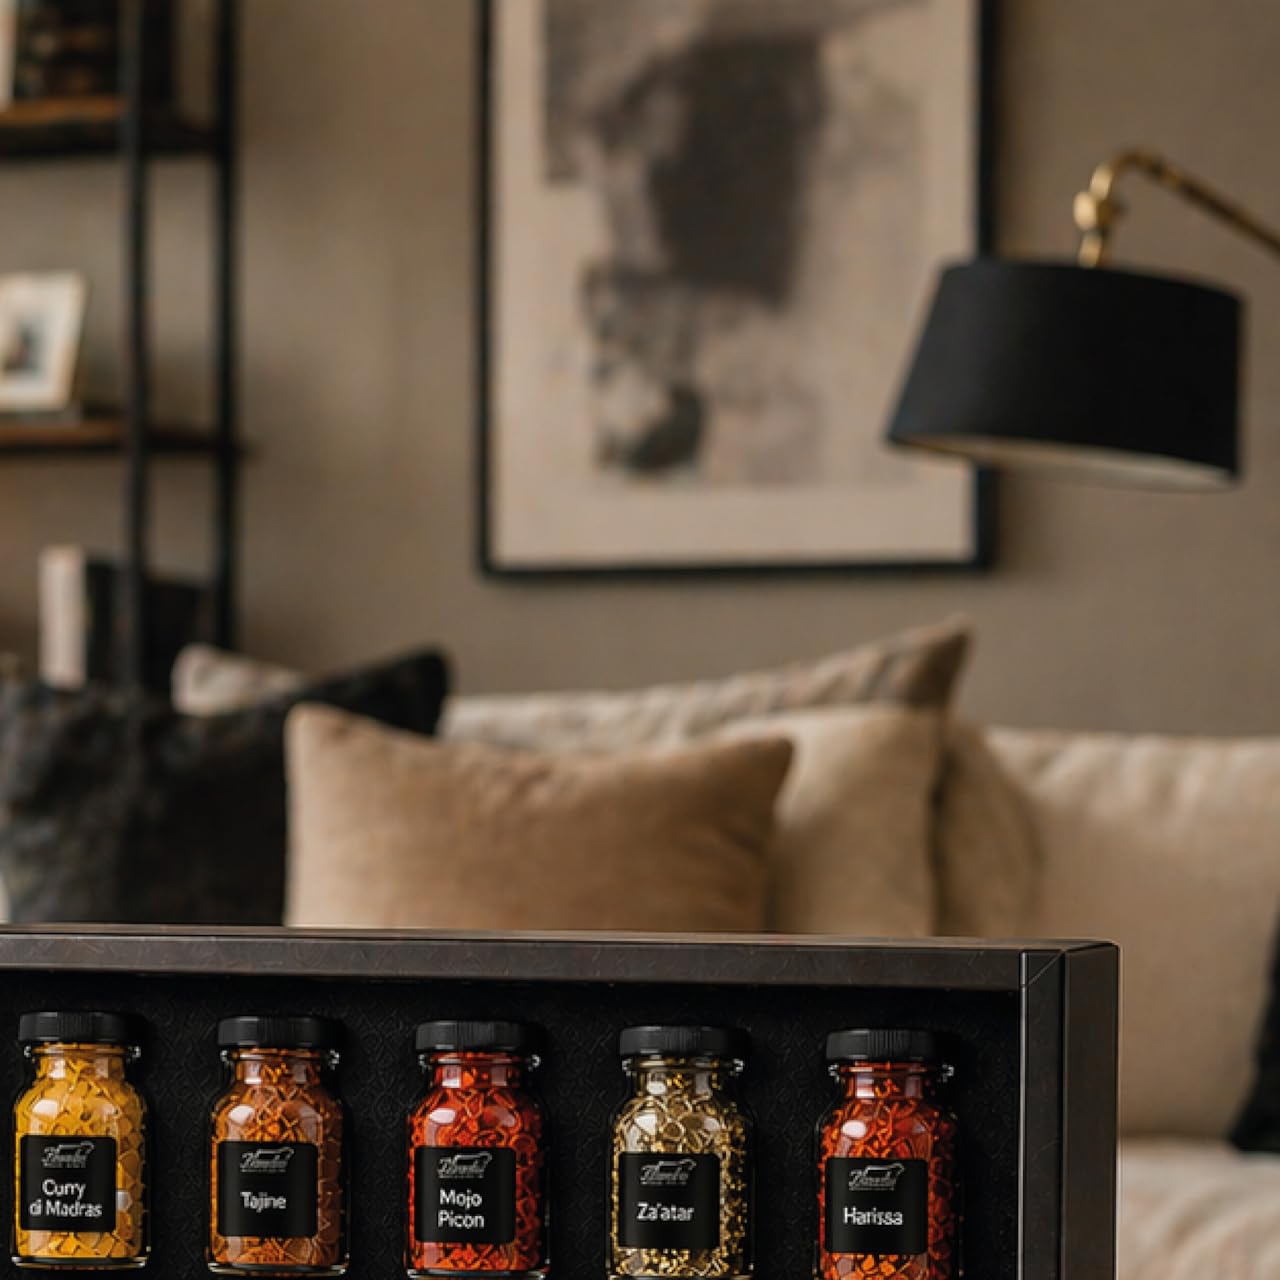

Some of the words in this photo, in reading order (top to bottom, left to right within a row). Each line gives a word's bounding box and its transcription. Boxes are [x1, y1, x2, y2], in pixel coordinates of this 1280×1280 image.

[42, 1178, 86, 1197] Curry
[29, 1200, 42, 1216] di
[45, 1199, 103, 1217] Madras
[240, 1191, 287, 1213] Tajine
[439, 1188, 483, 1209] Mojo
[437, 1209, 485, 1230] Picon
[843, 1206, 903, 1226] Harissa
